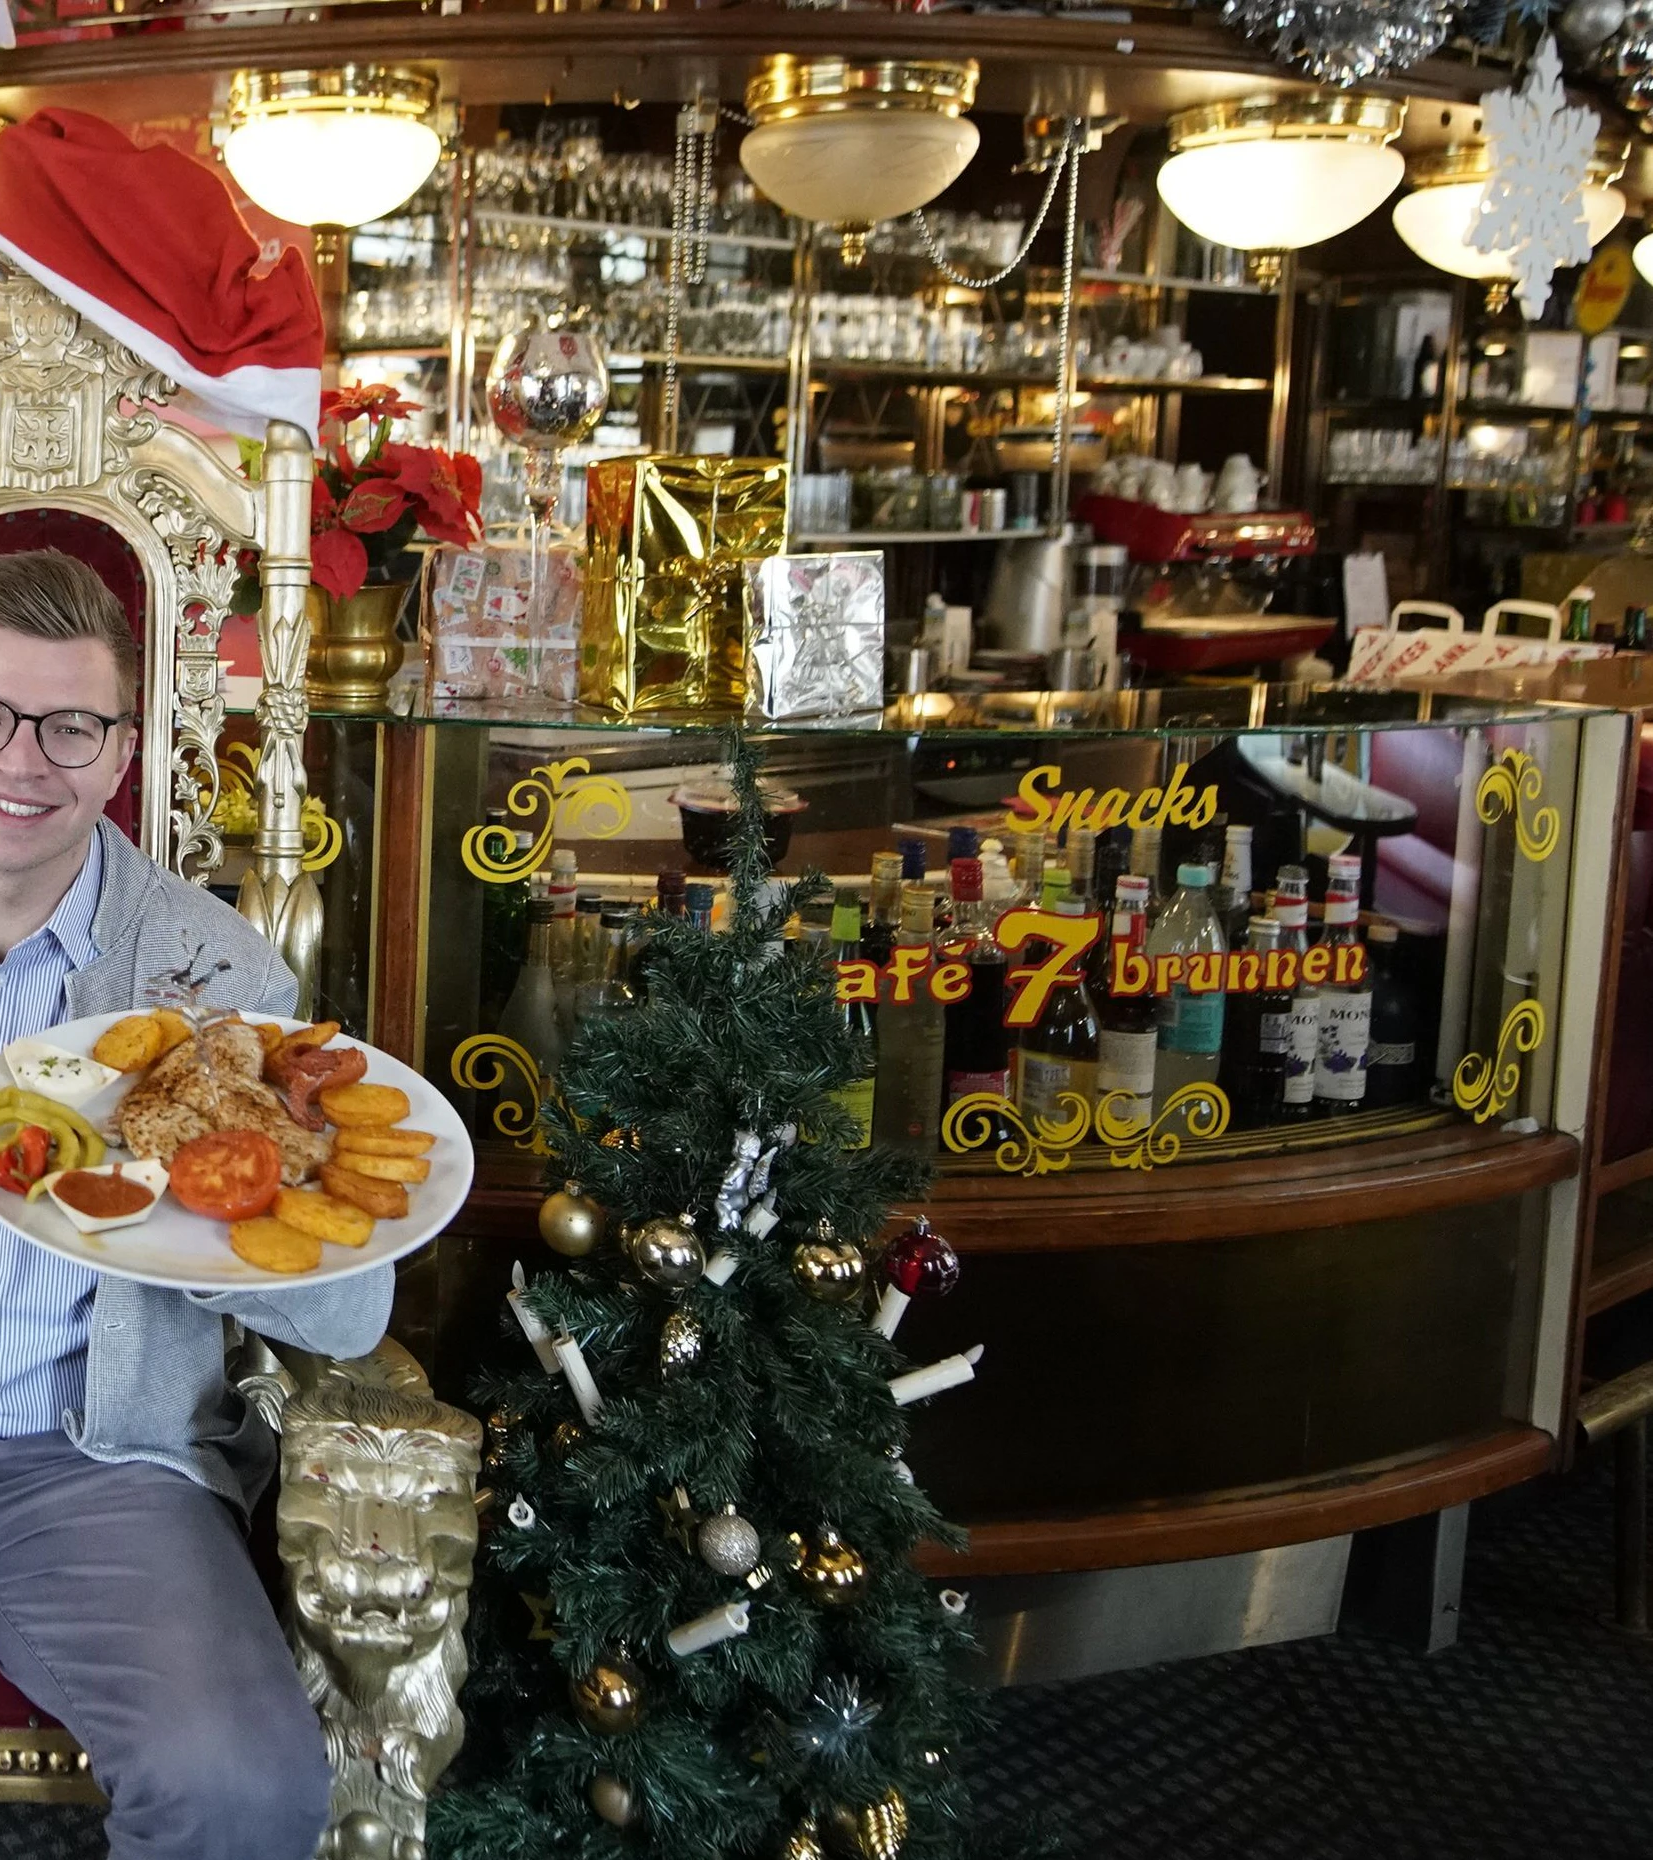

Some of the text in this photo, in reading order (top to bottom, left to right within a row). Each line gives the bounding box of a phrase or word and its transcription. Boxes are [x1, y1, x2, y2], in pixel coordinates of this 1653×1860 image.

[1005, 761, 1219, 832] Snacks
[832, 939, 976, 1004] afé
[994, 908, 1103, 1029] 7
[1110, 941, 1369, 999] brunnen
